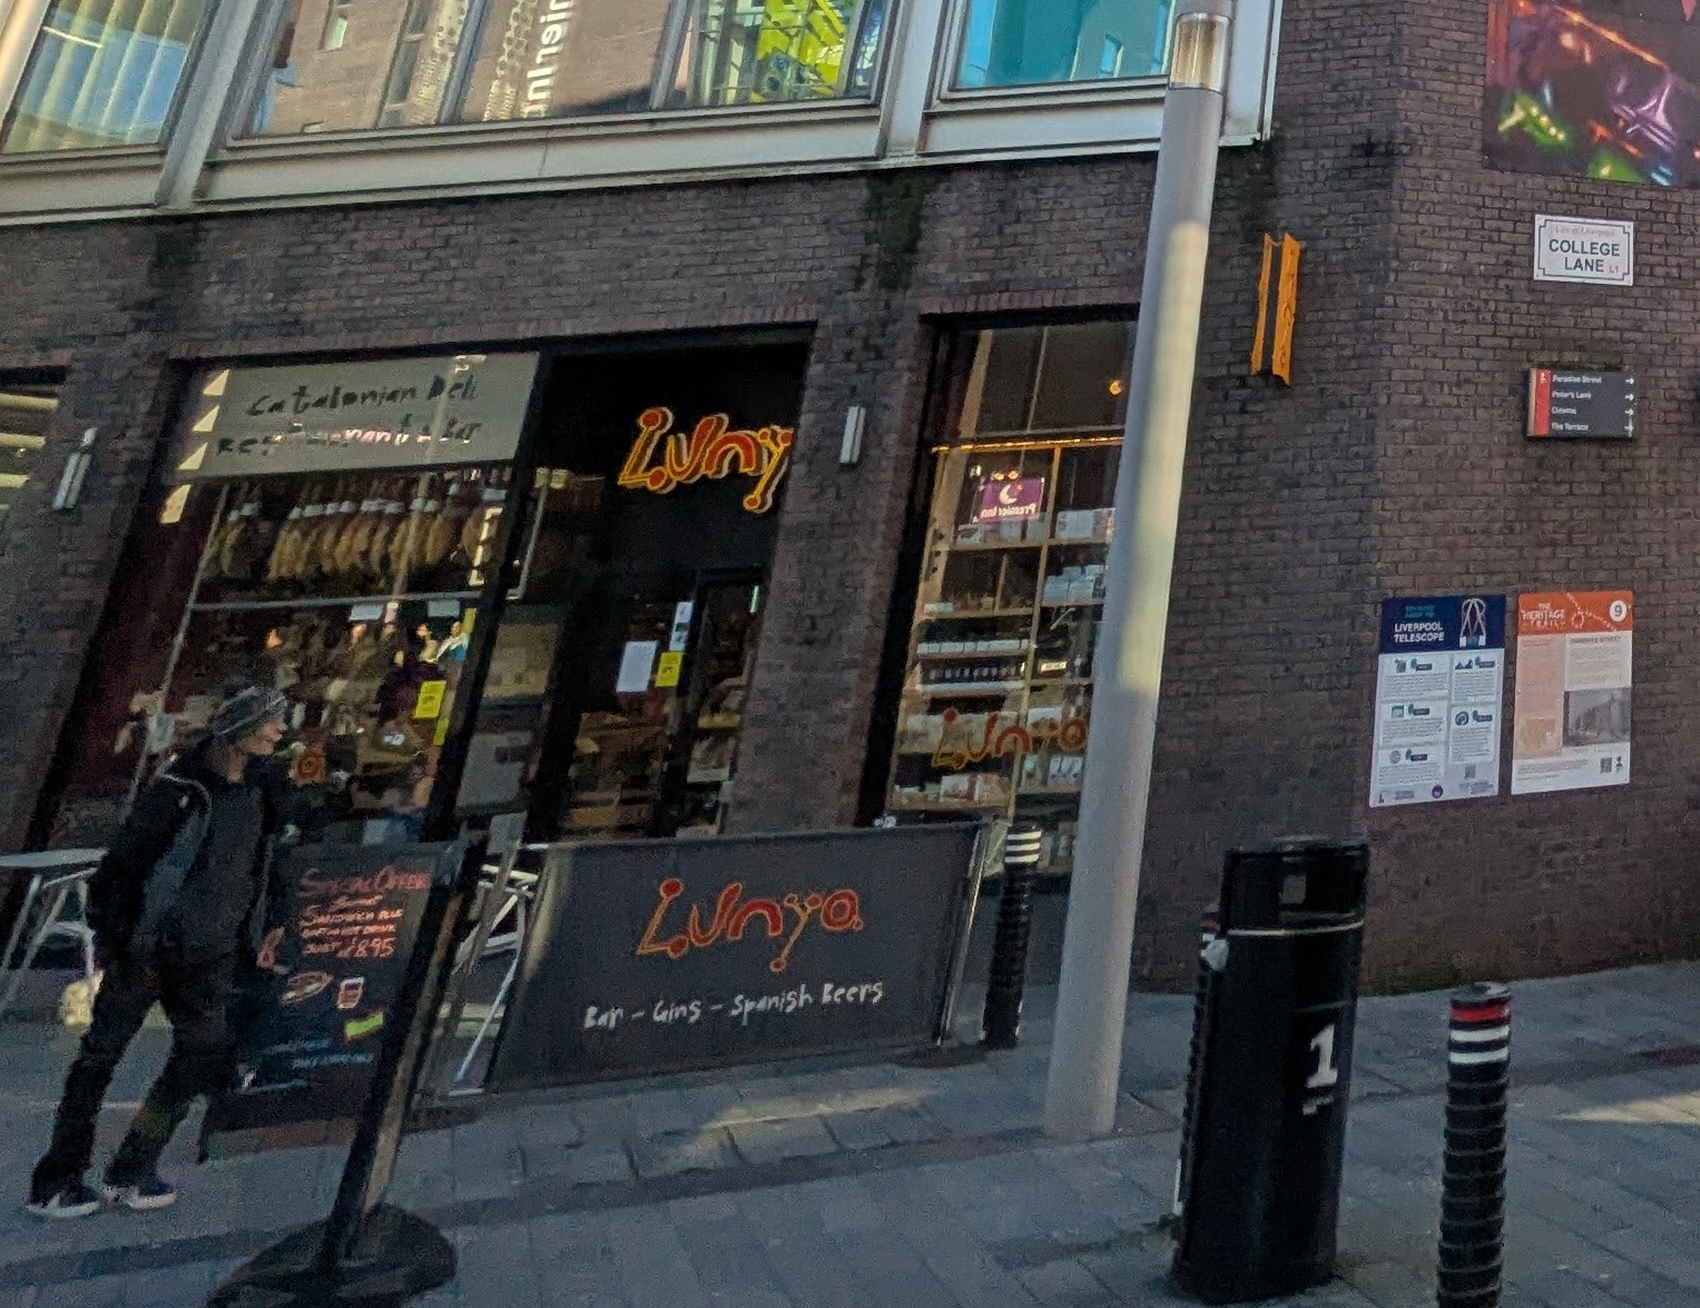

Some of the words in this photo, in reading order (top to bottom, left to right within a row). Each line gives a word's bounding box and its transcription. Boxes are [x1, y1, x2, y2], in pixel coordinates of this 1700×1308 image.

[1548, 238, 1620, 257] COLLEGE
[1564, 256, 1605, 272] LANE
[617, 406, 794, 514] Luny
[1613, 604, 1623, 617] 9
[1394, 622, 1444, 632] LIVERPOOL
[1393, 632, 1445, 643] TELESCOPE
[635, 878, 864, 973] Lunya
[583, 1005, 624, 1030] Bar
[653, 998, 702, 1024] Gins
[728, 983, 813, 1027] Spanish
[821, 980, 884, 1004] Beers
[1304, 1023, 1338, 1088] 1
